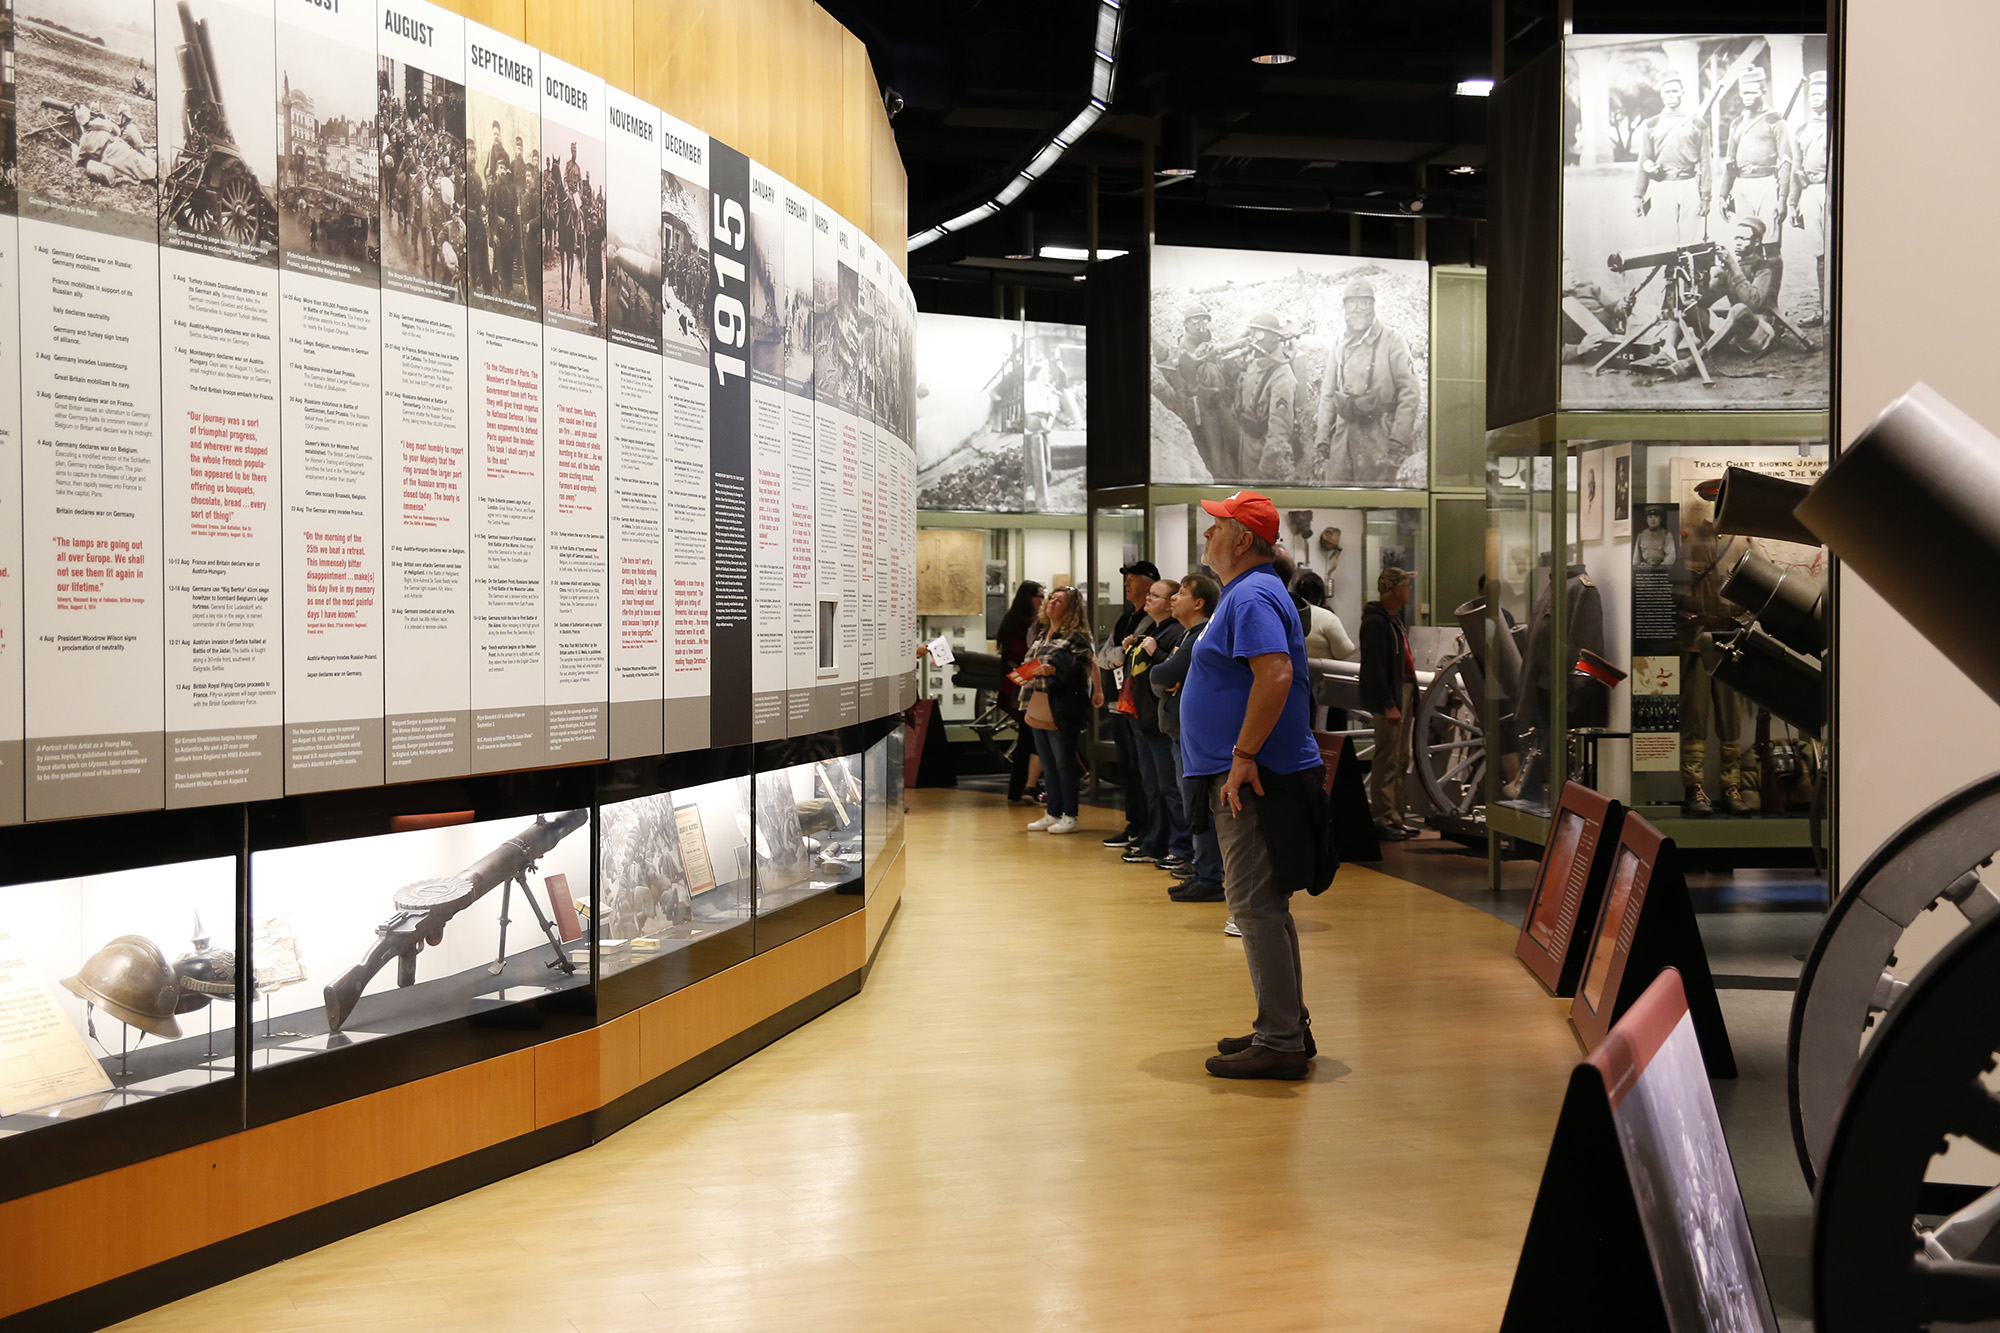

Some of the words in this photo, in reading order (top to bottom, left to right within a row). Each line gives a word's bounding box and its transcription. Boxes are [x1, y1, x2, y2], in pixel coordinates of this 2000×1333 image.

[385, 9, 434, 47] AUGUST
[472, 44, 533, 88] SEPTEMBER
[546, 76, 588, 112] OCTOBER
[610, 106, 653, 142] NOVEMBER
[665, 132, 702, 166] DECEMBER
[752, 178, 775, 204] JANUARY
[786, 196, 808, 224] FEBRUARY
[38, 246, 49, 255] Aug
[51, 248, 75, 260] Germany
[75, 253, 97, 262] declares
[114, 260, 133, 269] Russia;
[714, 192, 746, 386] 1915
[52, 306, 64, 315] Italy
[64, 308, 86, 317] declares
[86, 312, 111, 322] neutrality.
[40, 352, 51, 361] Aug
[53, 354, 77, 364] Germany
[77, 358, 97, 366] invades
[97, 360, 129, 371] Luxembourg.
[202, 412, 226, 426] journey
[227, 417, 240, 426] was
[247, 419, 259, 428] sort
[189, 425, 197, 435] of
[198, 426, 228, 439] triumphal
[229, 431, 258, 442] progress,
[41, 439, 52, 448] Aug
[55, 440, 78, 450] Germany
[118, 446, 139, 454] Belgium.
[190, 440, 202, 449] and
[203, 441, 233, 452] wherever
[234, 446, 243, 454] we
[244, 445, 268, 457] stopped
[406, 441, 415, 452] beg
[415, 443, 427, 451] most
[428, 443, 444, 455] humbly
[444, 445, 450, 454] to
[450, 447, 464, 456] report
[190, 453, 201, 463] the
[202, 455, 221, 465] whole
[222, 456, 243, 467] French
[244, 459, 266, 470] popula-
[190, 467, 203, 477] tion
[204, 470, 234, 480] appeared
[234, 471, 242, 480] to
[242, 472, 250, 481] be
[251, 472, 267, 482] there
[190, 481, 216, 495] offering
[225, 484, 256, 496] bouquets,
[190, 495, 224, 507] chocolate,
[224, 498, 242, 508] bread
[250, 501, 267, 511] every
[113, 510, 136, 519] Germany.
[191, 510, 204, 519] sort
[205, 510, 212, 520] of
[52, 536, 71, 547] “The
[72, 537, 95, 550] lamps
[96, 540, 109, 549] are
[110, 539, 130, 552] going
[131, 540, 143, 550] out
[314, 532, 324, 541] the
[324, 533, 346, 545] morning
[347, 534, 353, 542] of
[353, 534, 362, 543] the
[306, 544, 319, 554] 25th
[329, 546, 341, 555] beat
[346, 547, 366, 556] retreat.
[56, 552, 67, 562] all
[68, 554, 85, 563] over
[86, 552, 114, 565] Europe.
[114, 554, 126, 564] We
[128, 554, 145, 564] shall
[306, 557, 318, 567] This
[319, 558, 347, 570] immensely
[348, 559, 362, 568] bitter
[57, 567, 69, 577] not
[71, 569, 84, 577] see
[85, 567, 104, 578] them
[106, 568, 114, 578] lit
[115, 569, 135, 581] again
[136, 569, 144, 578] in
[306, 570, 347, 582] disappointment
[354, 572, 375, 583] make[s]
[57, 583, 70, 592] our
[71, 582, 104, 592] lifetime.”
[306, 584, 317, 593] this
[318, 584, 328, 595] day
[329, 584, 339, 593] live
[339, 584, 345, 593] in
[346, 586, 354, 595] my
[355, 586, 375, 596] memory
[307, 610, 320, 621] days
[320, 610, 323, 618] I
[324, 610, 337, 619] have
